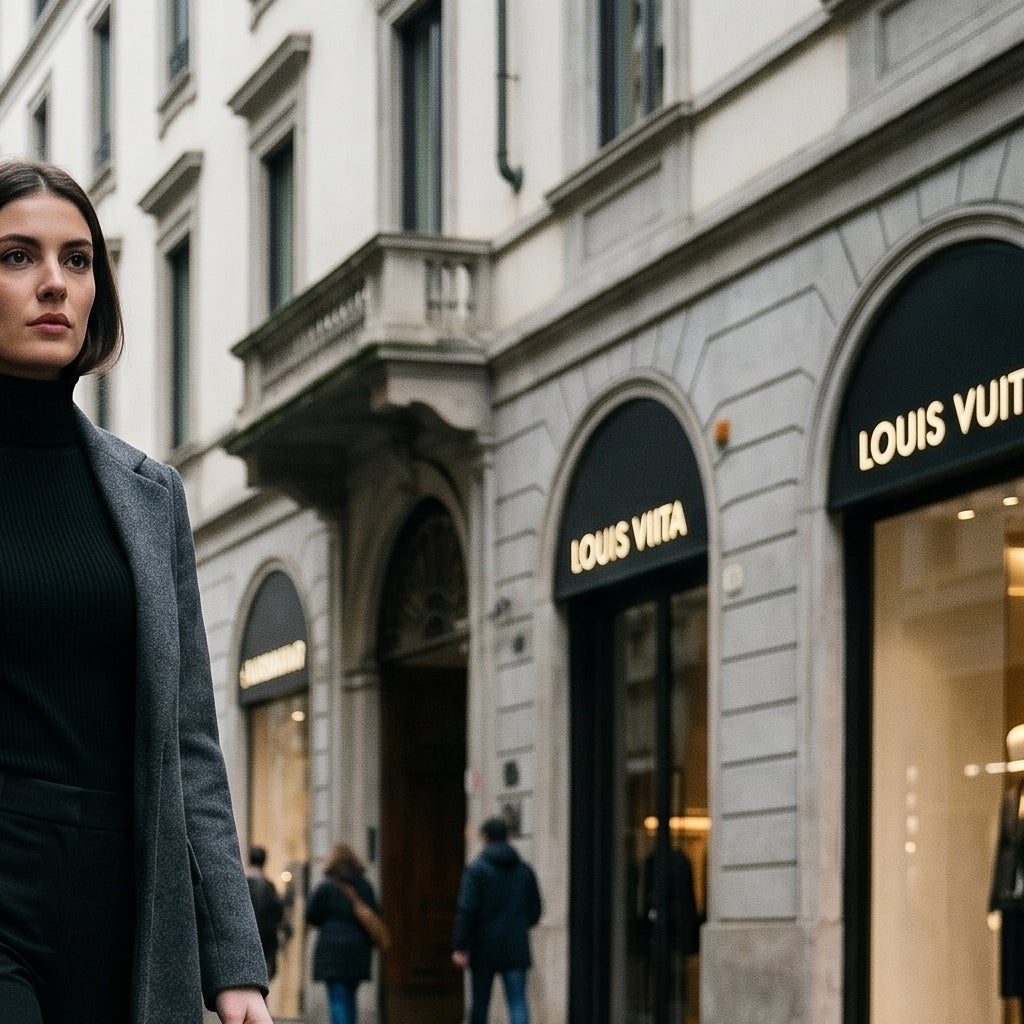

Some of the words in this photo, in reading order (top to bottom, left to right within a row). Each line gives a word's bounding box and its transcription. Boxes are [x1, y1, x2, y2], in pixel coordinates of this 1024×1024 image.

[858, 399, 946, 472] LOUIS
[952, 367, 1024, 436] VUIT
[570, 519, 631, 575] LOUIS
